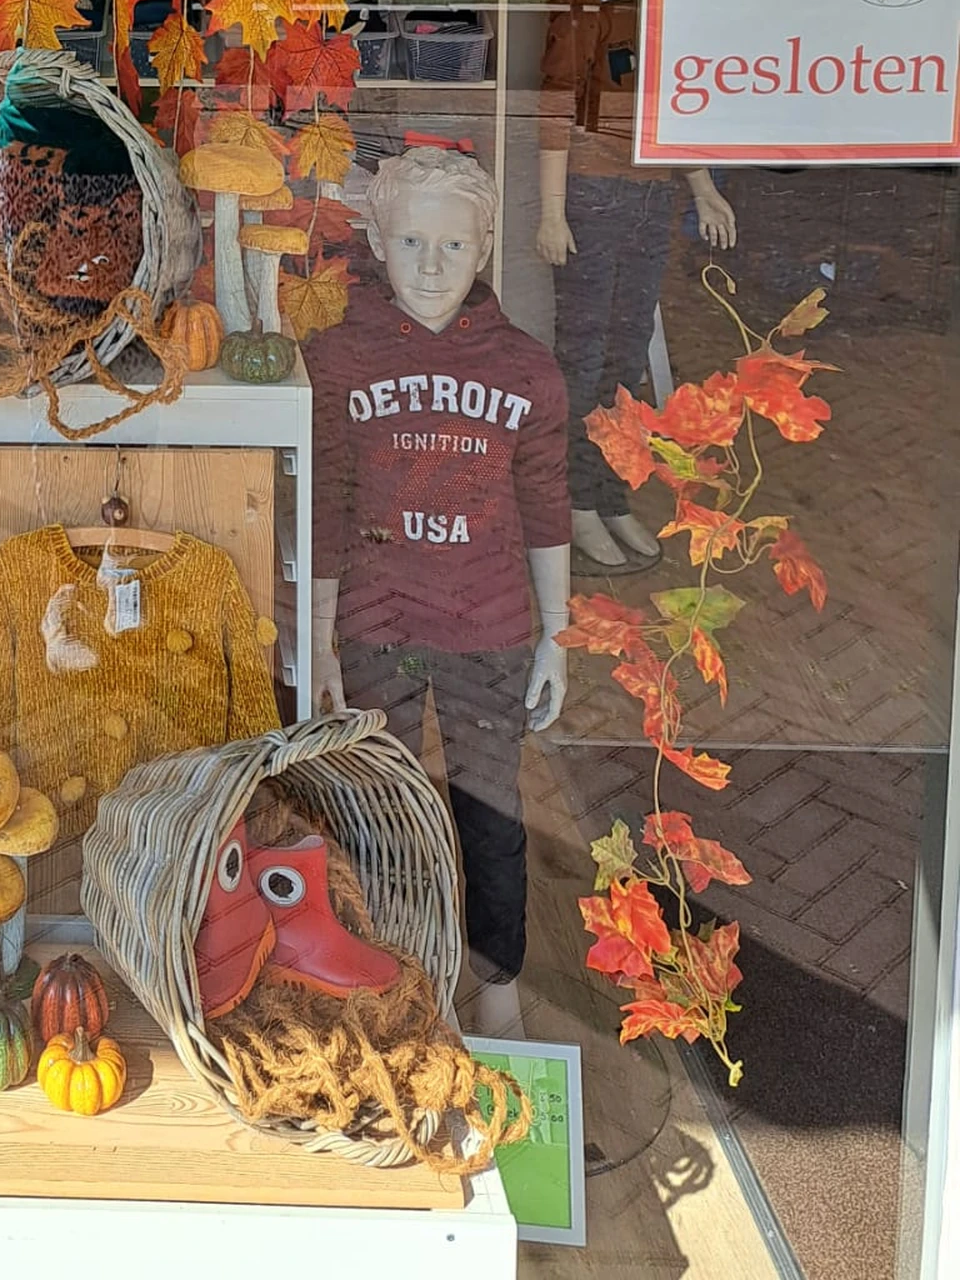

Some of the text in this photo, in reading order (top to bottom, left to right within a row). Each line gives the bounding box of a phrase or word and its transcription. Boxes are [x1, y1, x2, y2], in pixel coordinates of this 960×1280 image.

[670, 36, 949, 115] gesloten
[348, 374, 532, 431] DETROIT
[392, 432, 488, 455] IGNITION
[402, 510, 471, 543] USA
